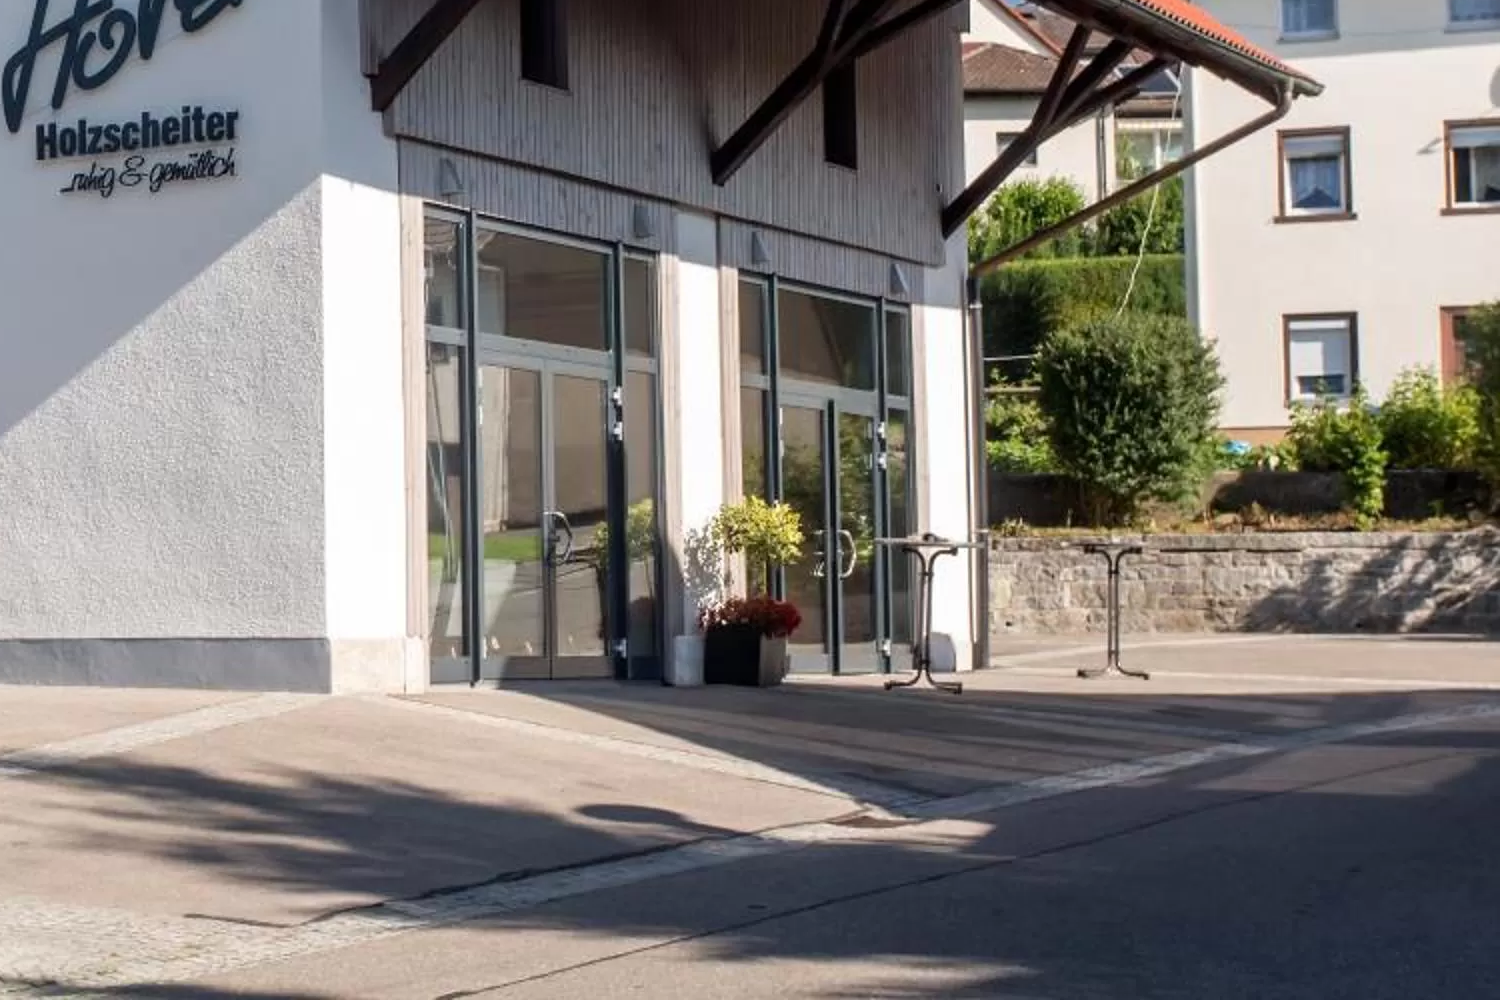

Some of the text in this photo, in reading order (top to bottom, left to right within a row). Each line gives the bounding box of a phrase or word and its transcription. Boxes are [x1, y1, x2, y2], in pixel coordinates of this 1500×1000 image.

[35, 105, 239, 160] Holzscheiter
[119, 156, 148, 186] &
[149, 148, 236, 193] gemütlich
